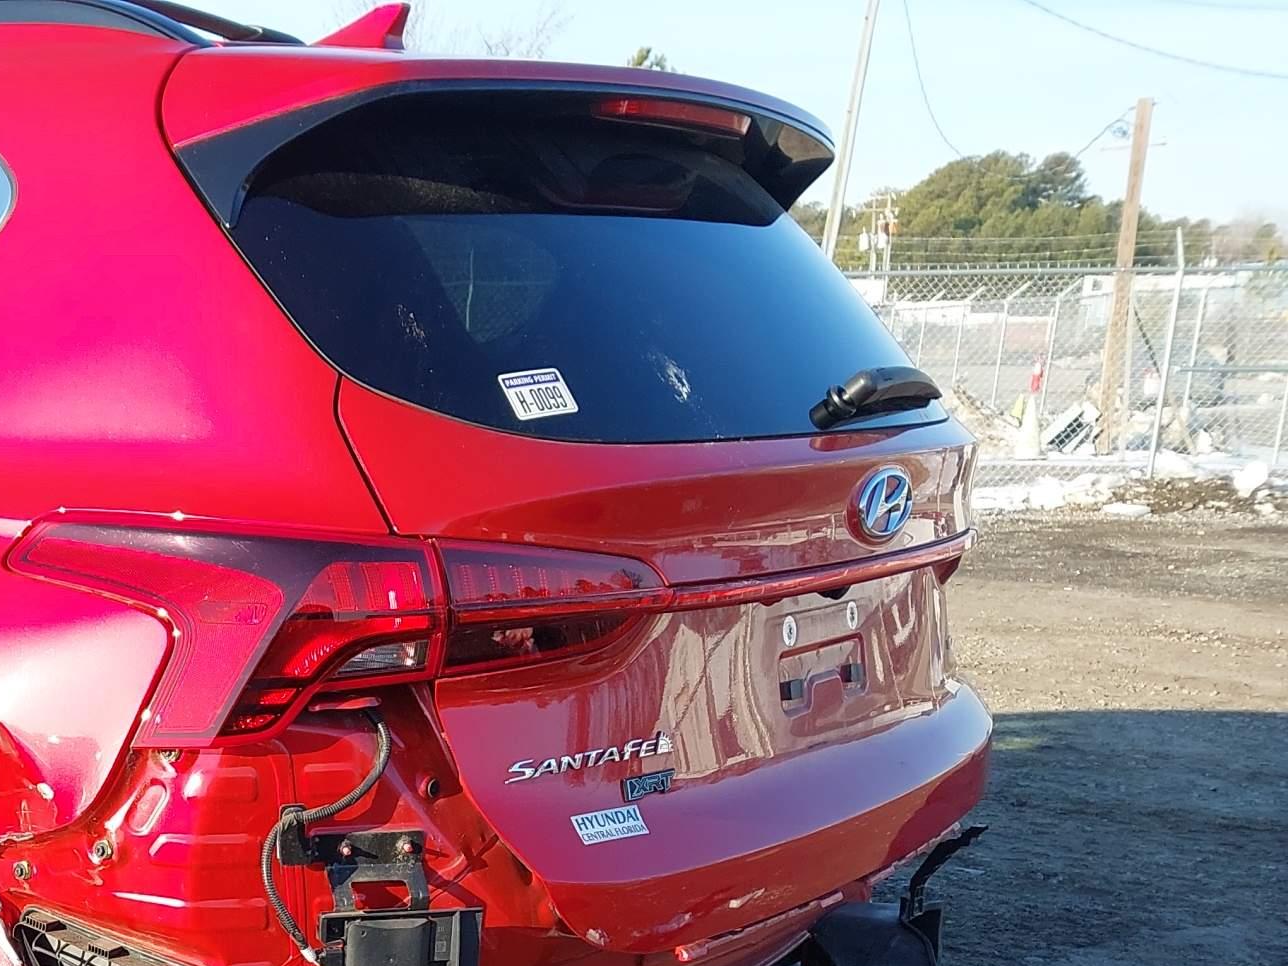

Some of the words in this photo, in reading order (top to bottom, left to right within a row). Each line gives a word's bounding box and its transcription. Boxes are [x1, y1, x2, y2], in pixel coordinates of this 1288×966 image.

[504, 376, 534, 388] PARKING
[515, 386, 568, 414] H-0099
[626, 769, 675, 801] XRT
[575, 807, 640, 832] HYUNDAI
[582, 828, 616, 843] CENTRAL
[614, 823, 647, 836] FLORIDA
